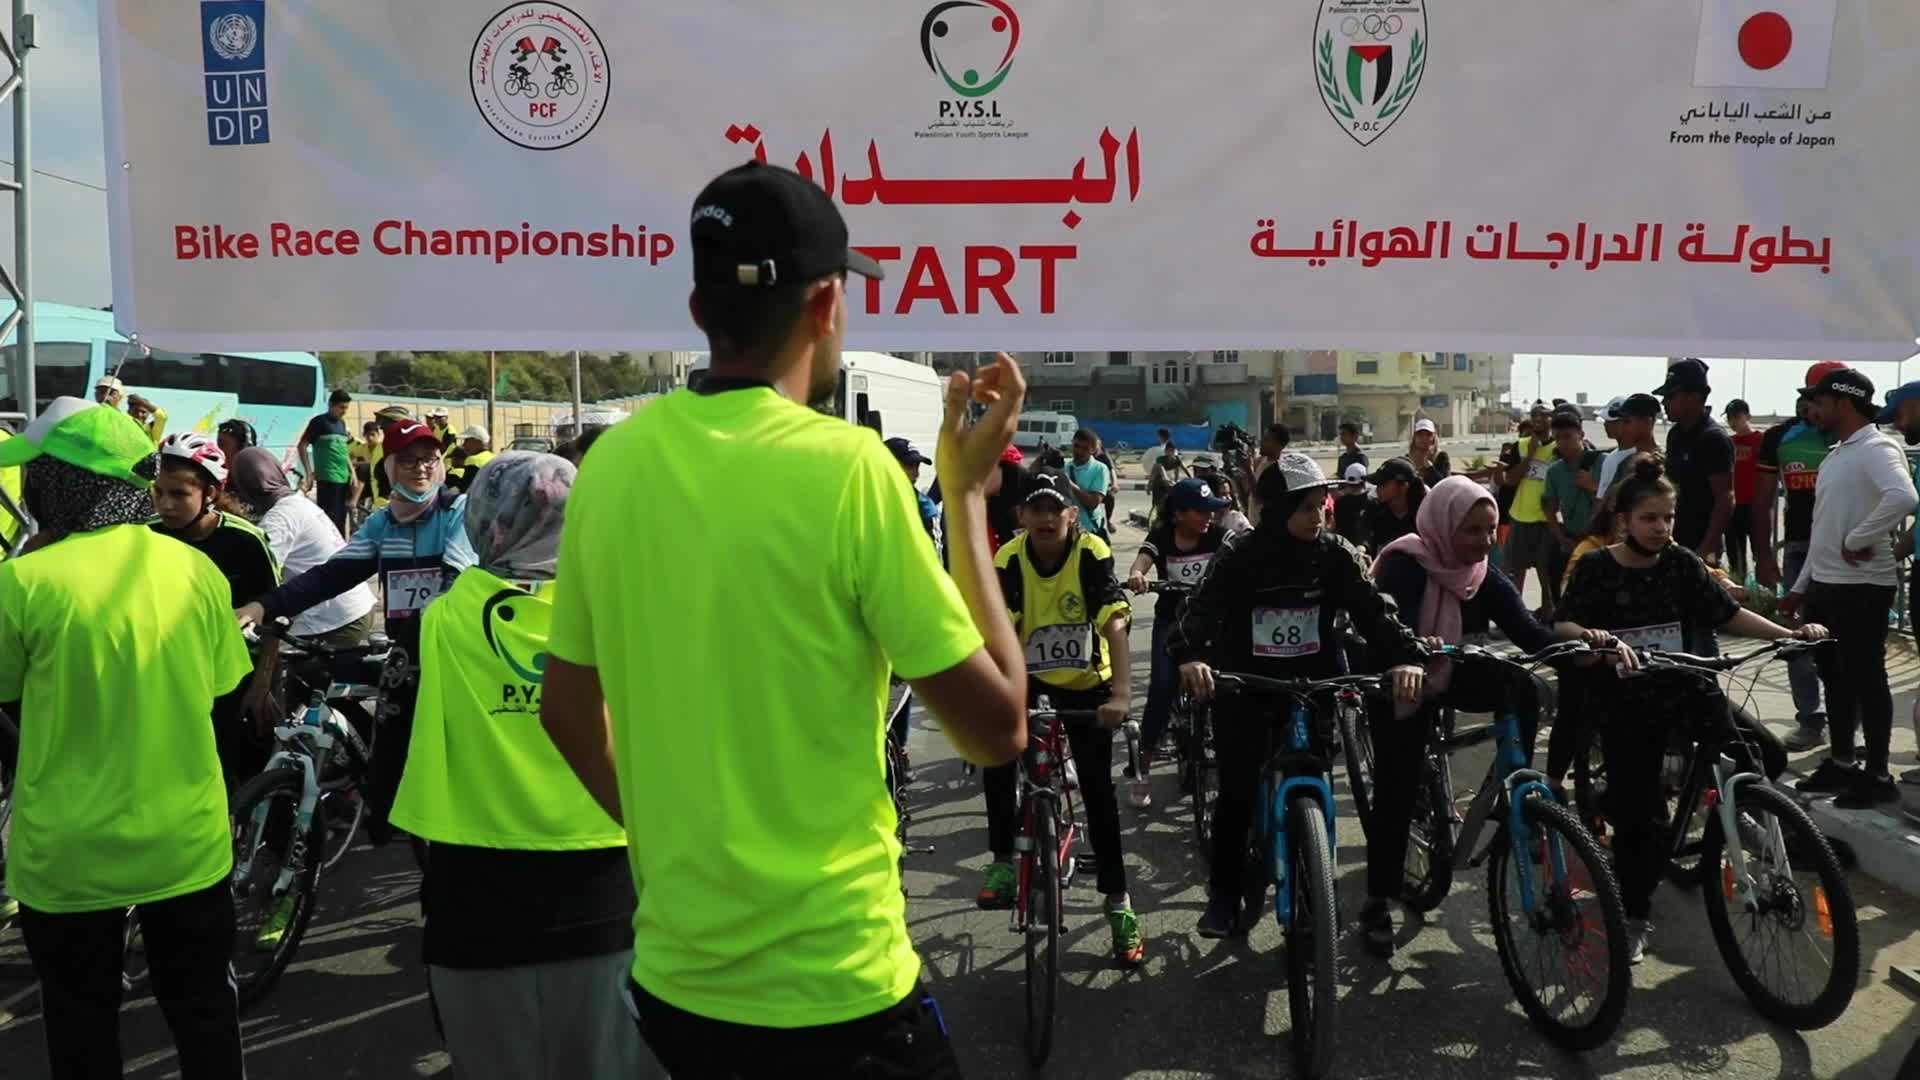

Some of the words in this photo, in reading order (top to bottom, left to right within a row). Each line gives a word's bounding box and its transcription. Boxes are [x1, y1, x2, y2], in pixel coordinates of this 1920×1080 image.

[529, 102, 558, 118] PCF
[939, 100, 1002, 118] P.Y.S.L
[1679, 101, 1750, 126] الياباني
[1754, 101, 1801, 124] الشعب
[1805, 106, 1833, 125] من
[1353, 121, 1380, 132] P.O.C
[1669, 131, 1704, 144] From
[1709, 130, 1731, 144] the
[1735, 131, 1776, 148] People
[1779, 131, 1794, 145] of
[1796, 133, 1836, 149] Japan
[175, 225, 259, 259] Bike
[270, 221, 360, 256] Race
[373, 219, 675, 265] Championship
[1249, 218, 1452, 268] الهوائية
[1465, 221, 1663, 271] الدراجات
[1677, 222, 1832, 274] بطولة
[850, 245, 1078, 315] TART
[1831, 382, 1866, 397] adidas
[1182, 562, 1202, 577] 69
[1272, 625, 1301, 645] 68
[1035, 639, 1080, 660] 160
[503, 684, 541, 704] P.Y.
